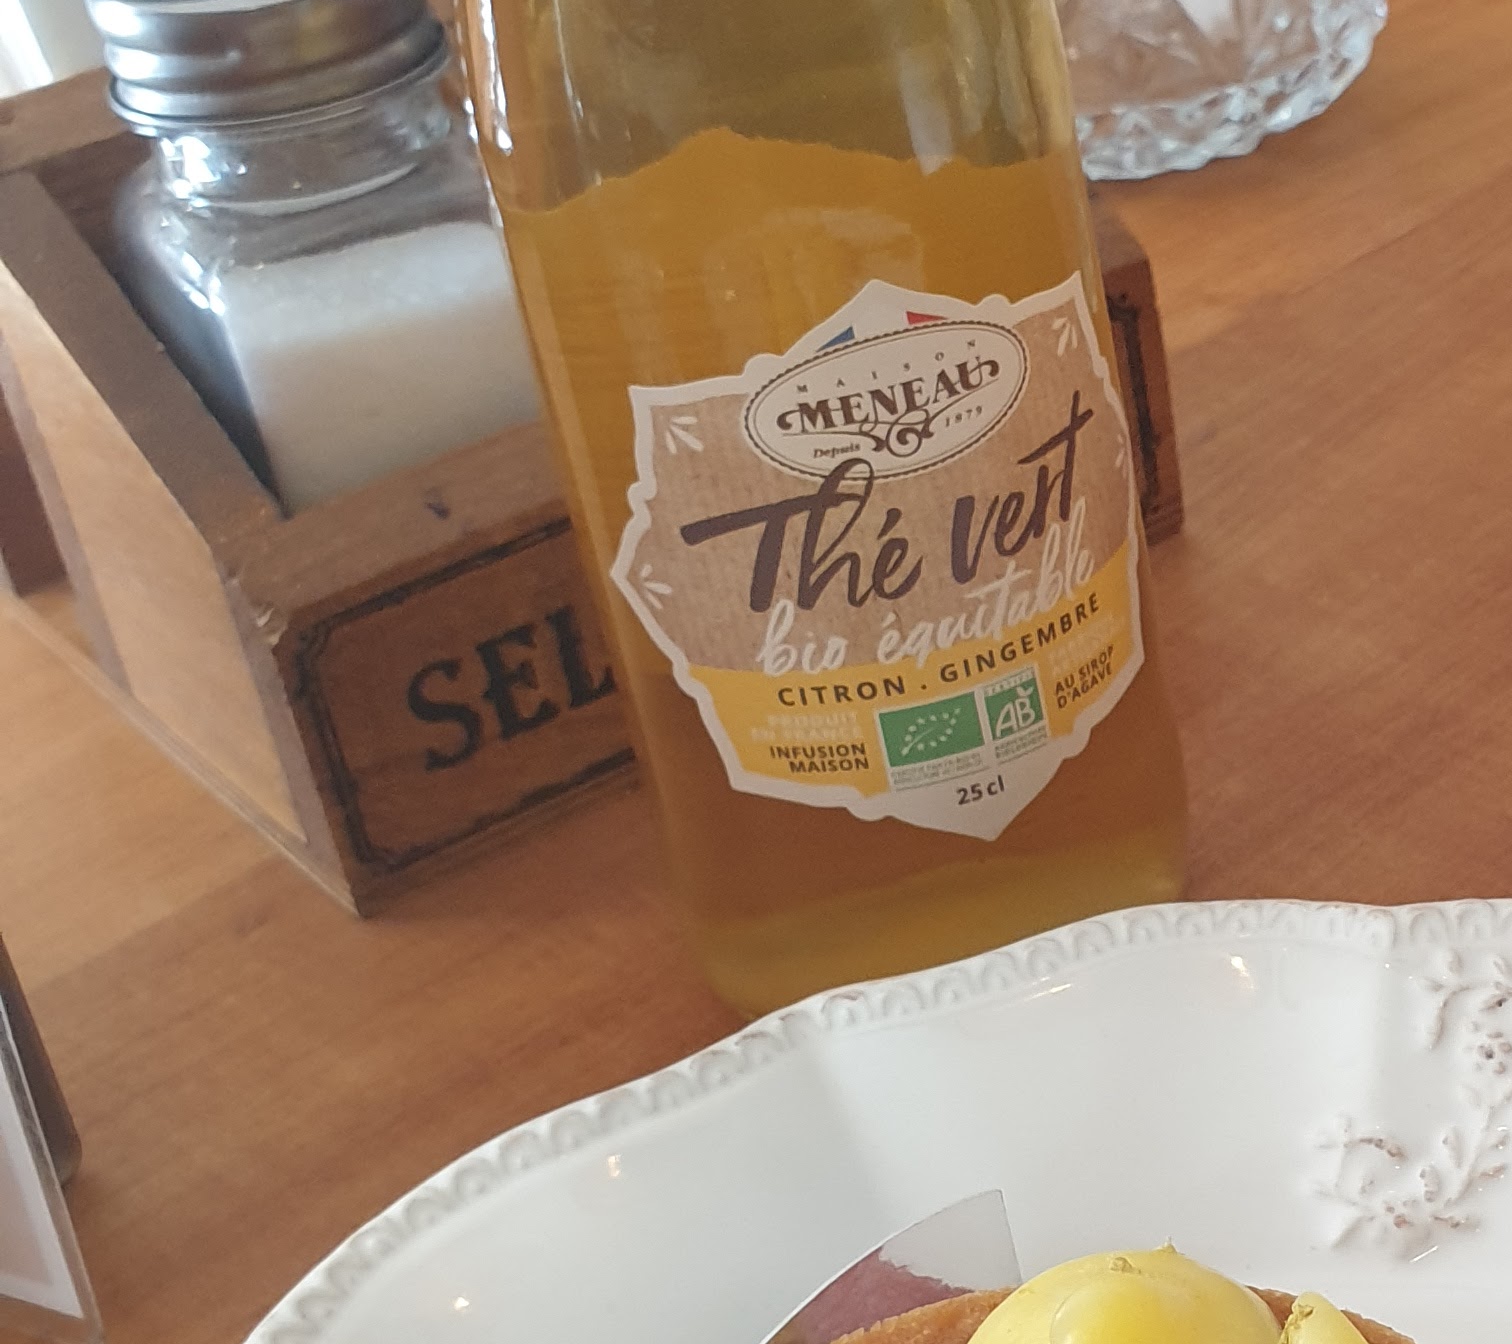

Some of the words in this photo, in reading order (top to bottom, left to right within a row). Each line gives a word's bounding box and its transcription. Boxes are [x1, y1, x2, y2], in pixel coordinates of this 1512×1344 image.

[777, 355, 1000, 435] MENEAU
[680, 458, 923, 612] Thé
[755, 598, 848, 677] bio
[876, 497, 1094, 669] équitable
[407, 605, 618, 772] SEL
[777, 676, 905, 707] CITRON
[940, 592, 1100, 683] GINGEMBRE
[1055, 674, 1076, 695] AU
[769, 742, 867, 759] INFUSION
[995, 697, 1036, 738] AB
[788, 757, 870, 773] MAISON
